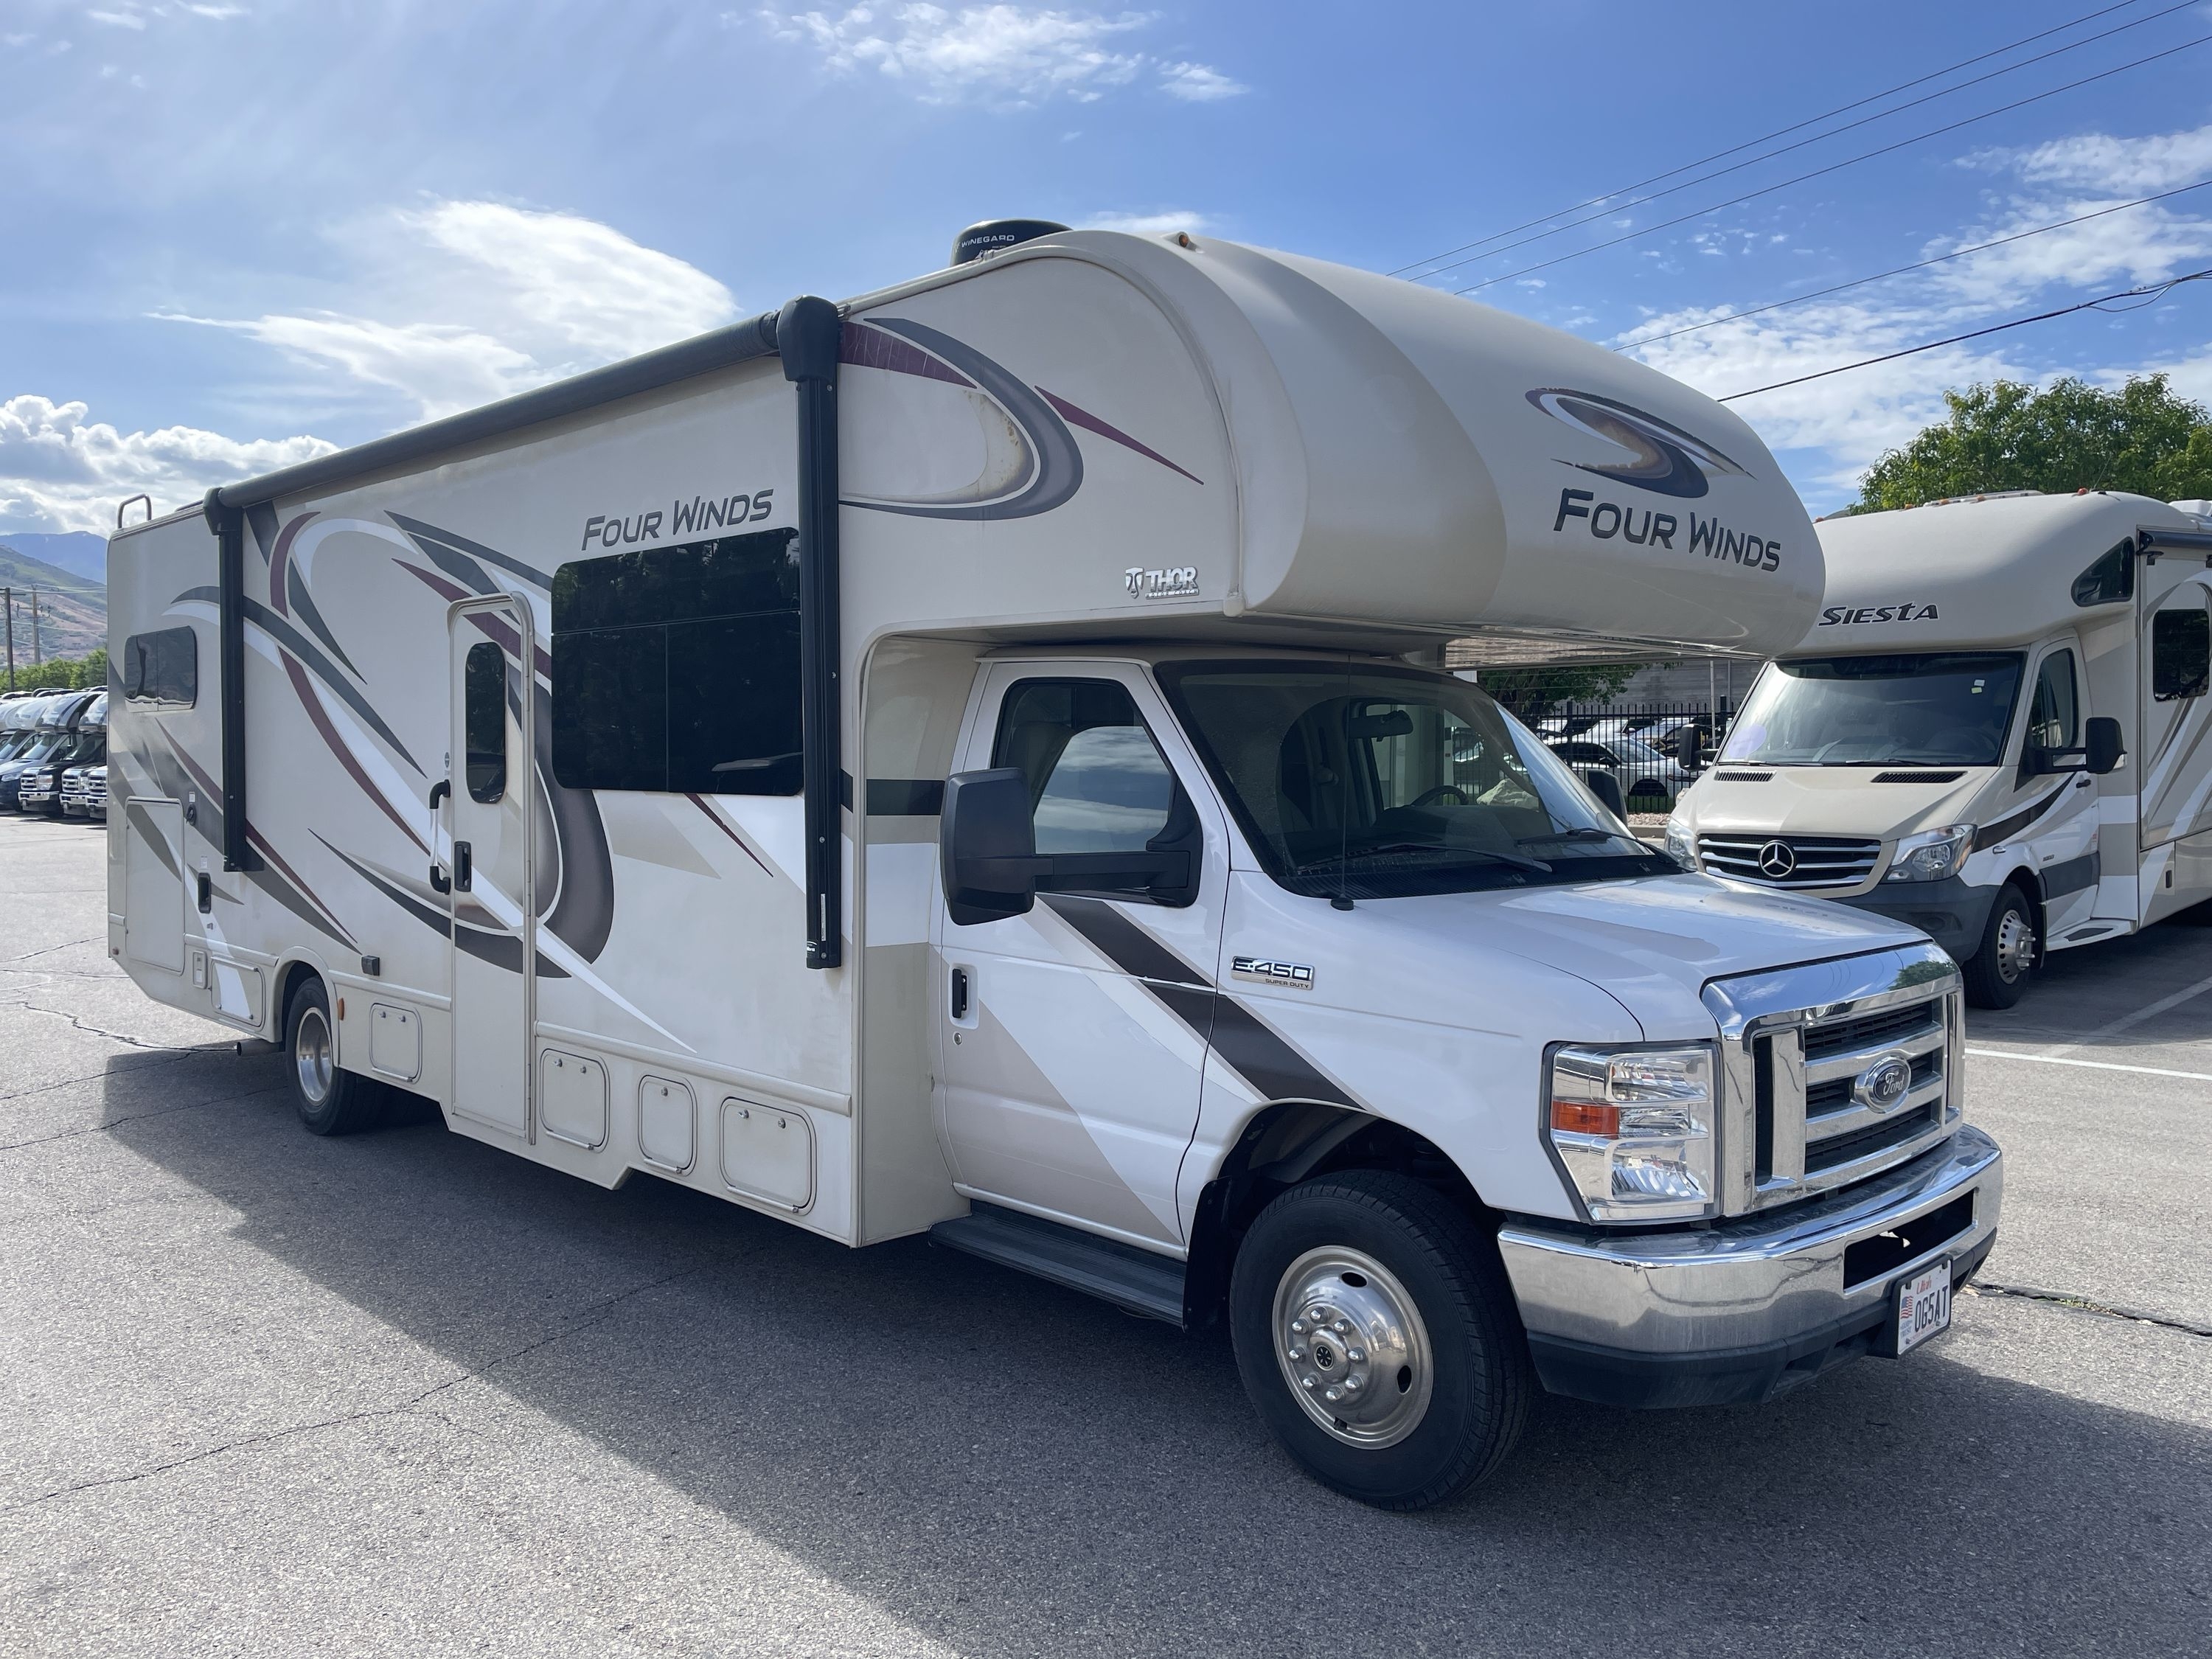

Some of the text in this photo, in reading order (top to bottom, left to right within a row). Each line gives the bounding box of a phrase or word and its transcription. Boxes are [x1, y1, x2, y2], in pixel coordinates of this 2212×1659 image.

[961, 234, 1015, 248] WINEGARD
[581, 488, 774, 551] FOUR WINDS
[1553, 487, 1781, 572] FOUR WINDS
[1145, 566, 1199, 592] THOR
[1232, 958, 1312, 981] E-450
[1882, 1071, 1905, 1096] Ford
